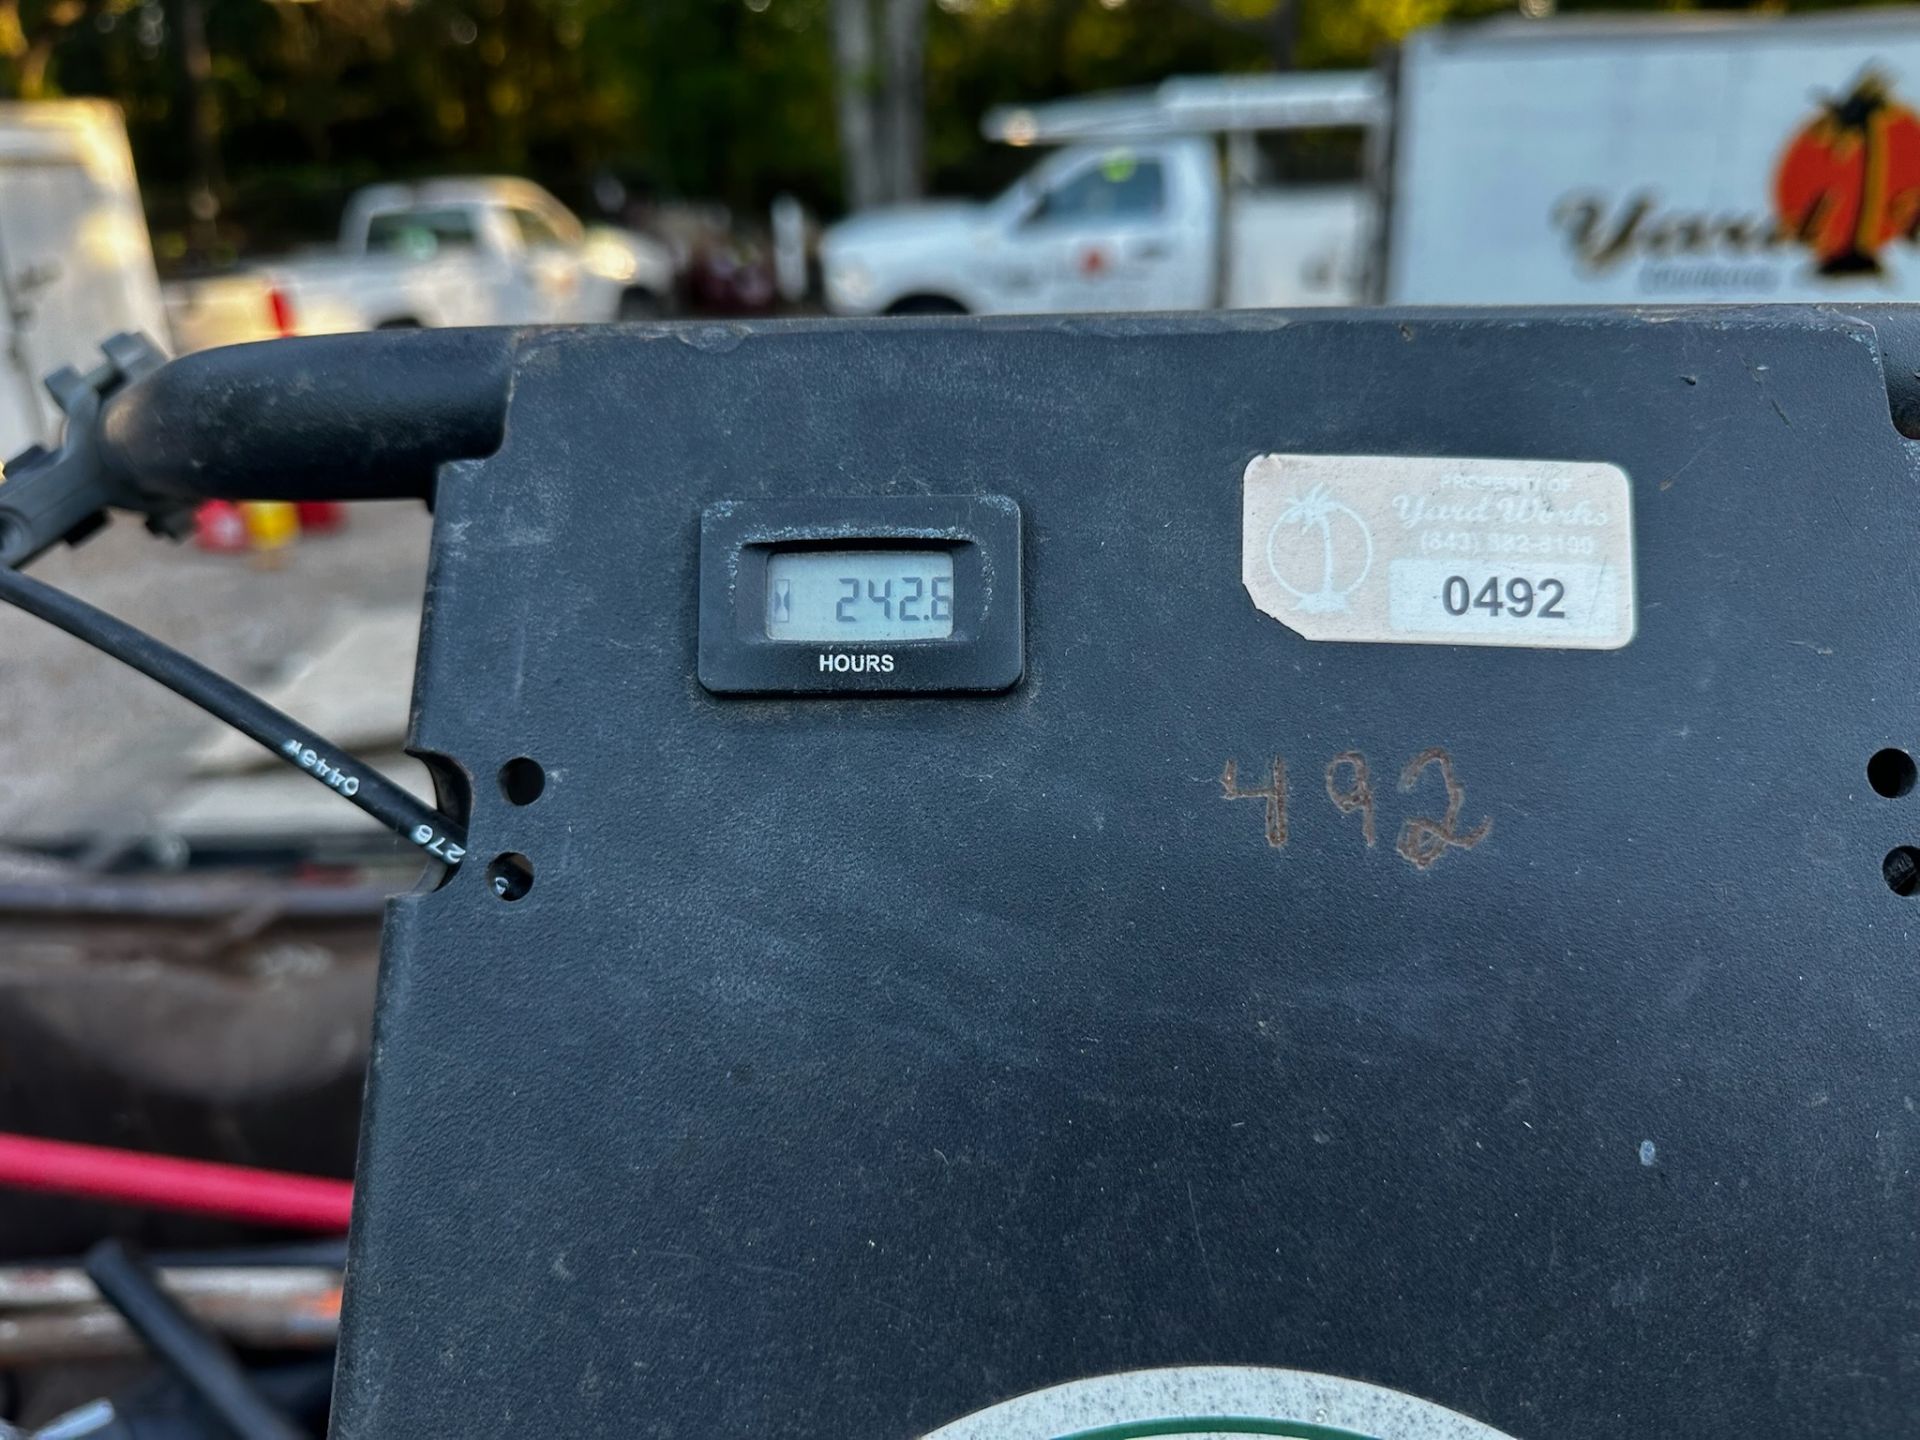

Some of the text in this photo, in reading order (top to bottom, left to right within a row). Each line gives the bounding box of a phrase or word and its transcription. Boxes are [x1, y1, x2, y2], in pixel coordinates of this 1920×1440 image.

[1392, 495, 1490, 528] Yard
[836, 577, 952, 622] 242.6
[1442, 575, 1566, 619] 0492
[819, 654, 895, 674] HOURS
